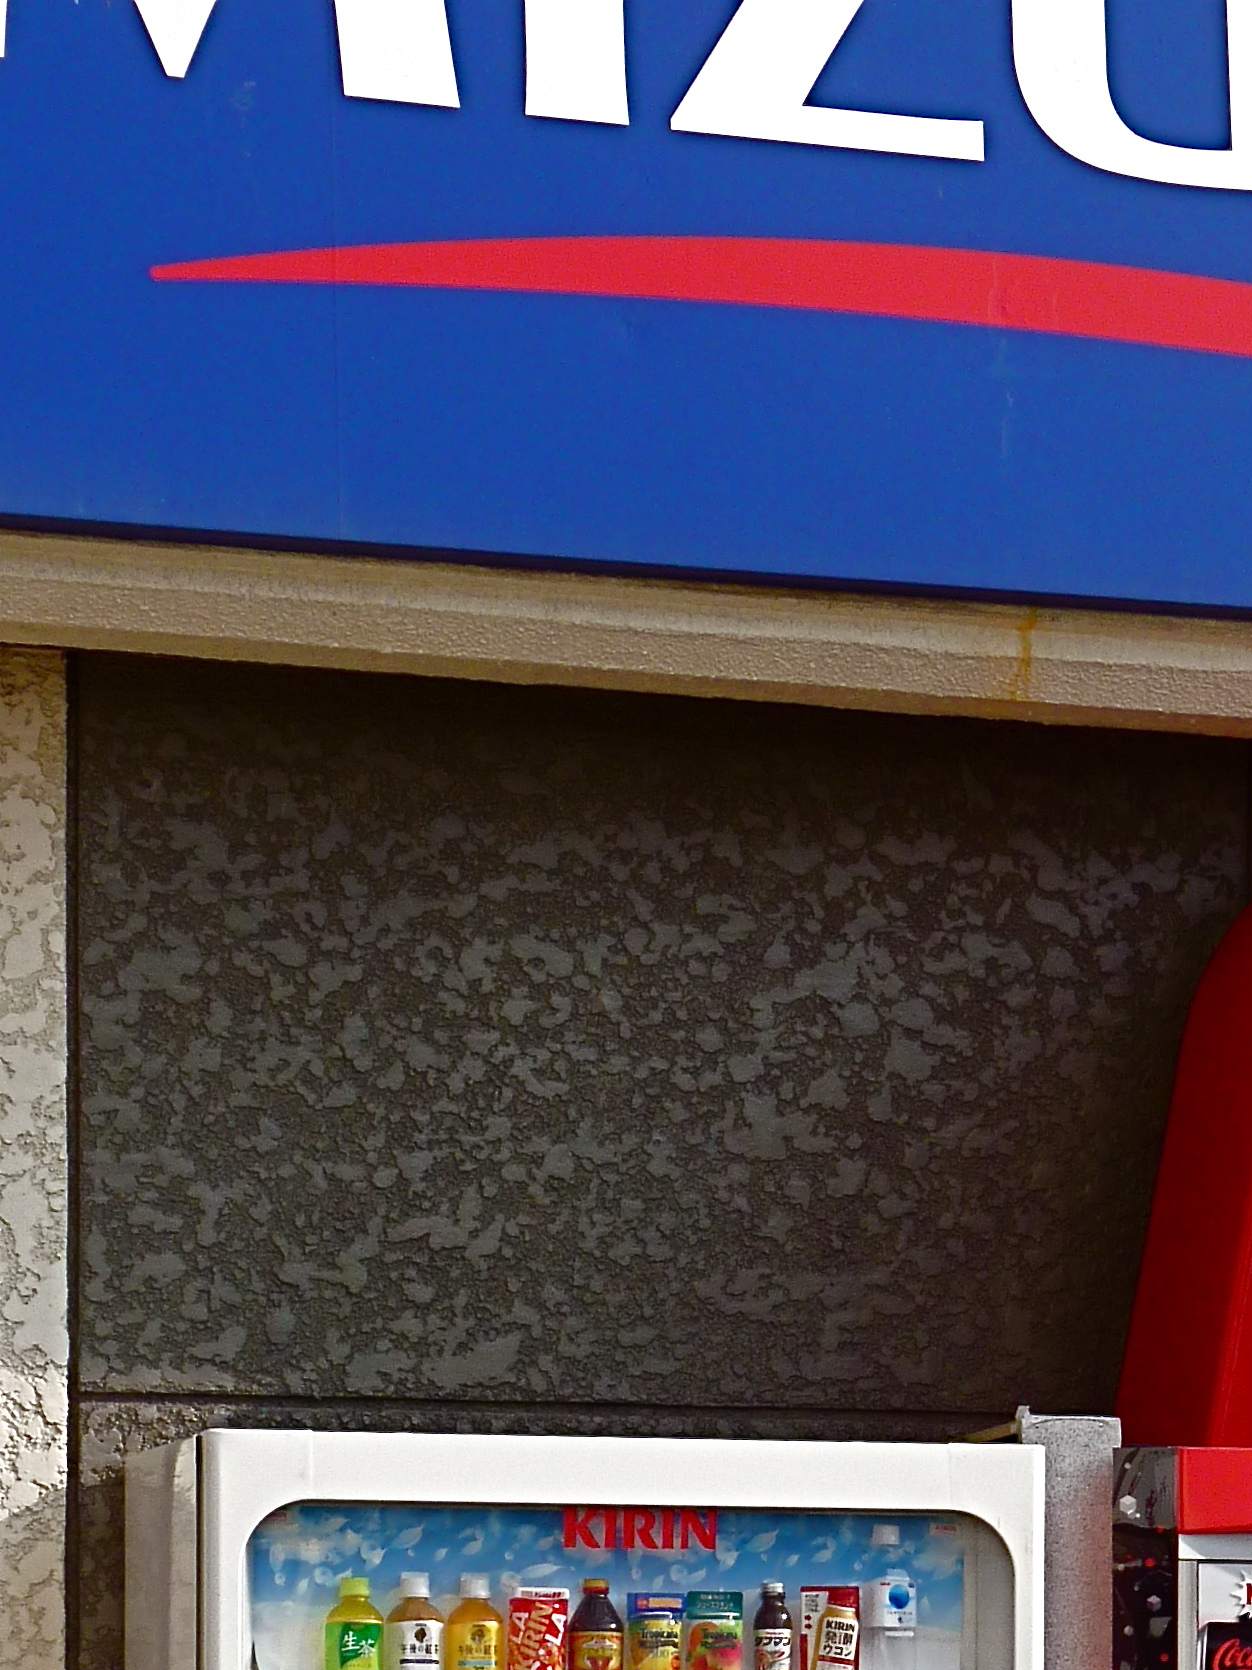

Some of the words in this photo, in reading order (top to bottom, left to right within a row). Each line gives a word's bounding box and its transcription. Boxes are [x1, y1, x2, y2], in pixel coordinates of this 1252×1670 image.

[561, 1505, 718, 1551] KIRIN
[825, 1619, 856, 1632] KIRIN
[341, 1631, 376, 1658] 生茶
[823, 1645, 853, 1657] ウコン
